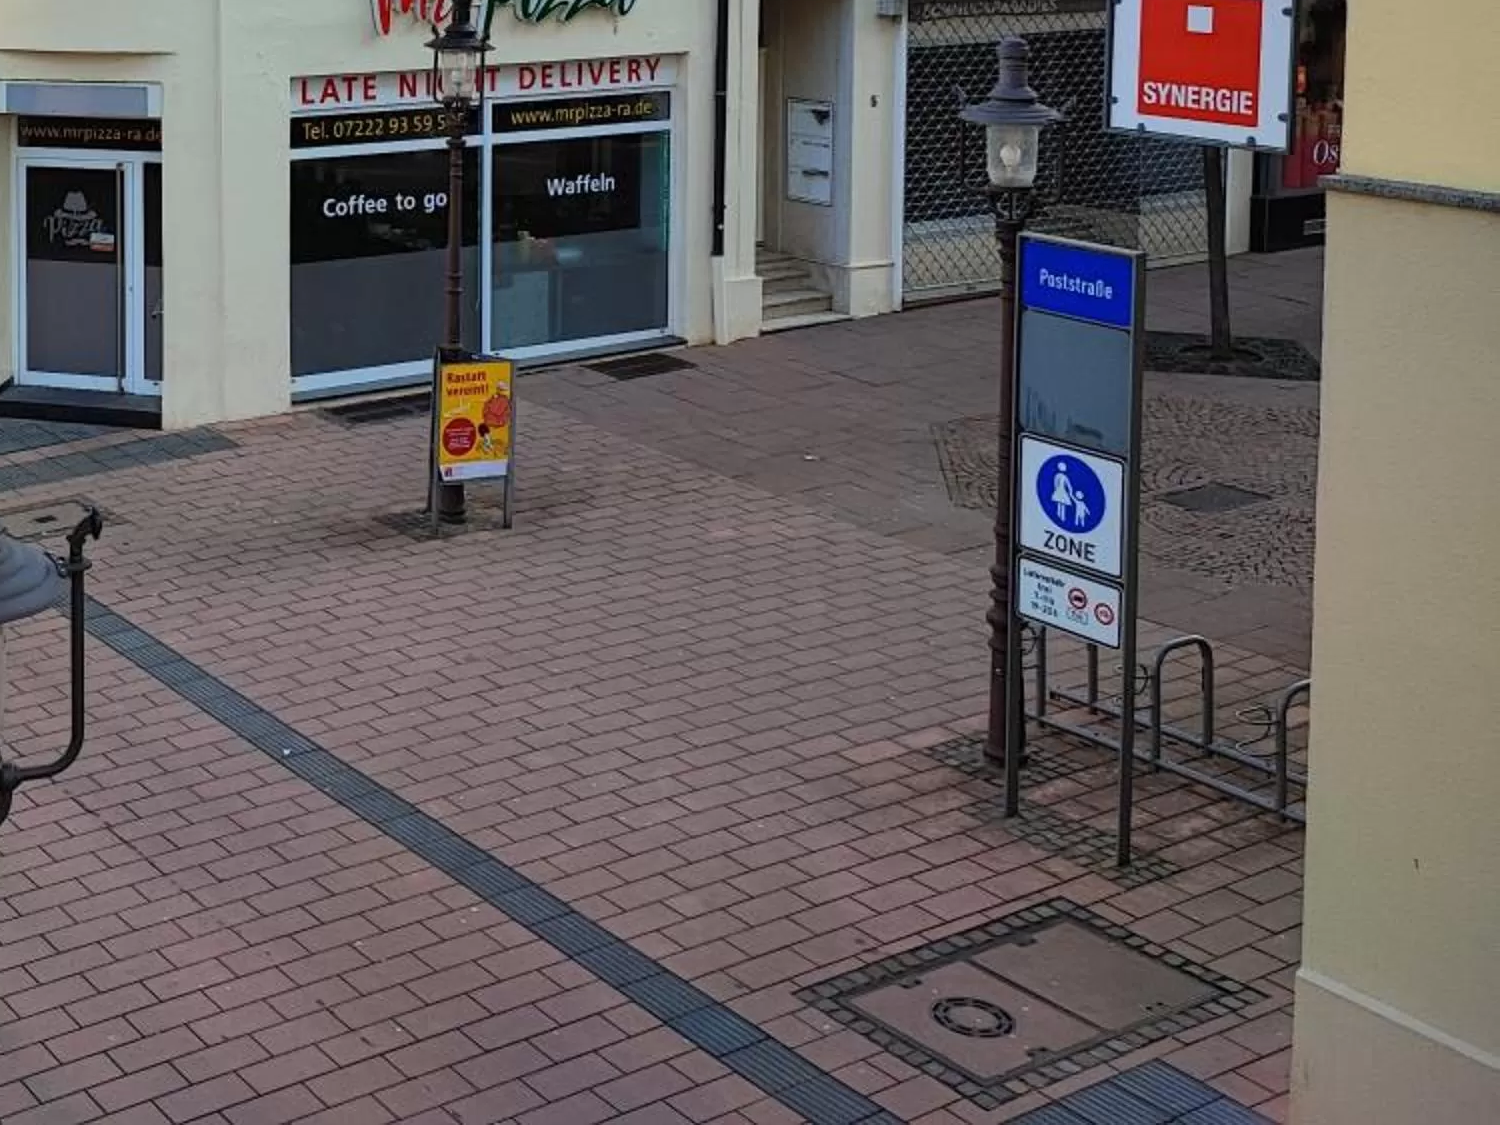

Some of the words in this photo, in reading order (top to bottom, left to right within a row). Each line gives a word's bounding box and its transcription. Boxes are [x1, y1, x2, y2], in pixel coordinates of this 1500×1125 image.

[301, 75, 377, 105] LATE
[398, 65, 501, 98] NIT
[519, 57, 661, 90] DELIVERY
[1143, 80, 1253, 115] SYNERGIE
[510, 100, 652, 125] www.mrpizza-ra.de
[302, 122, 329, 140] Tel.
[333, 118, 384, 139] 07222
[389, 117, 408, 134] 93
[413, 115, 433, 132] 59
[546, 173, 615, 196] Waffeln
[323, 194, 387, 217] Coffee
[395, 193, 415, 210] to
[423, 192, 447, 213] go
[1039, 268, 1113, 300] Poststraße
[1043, 530, 1097, 564] ZONE
